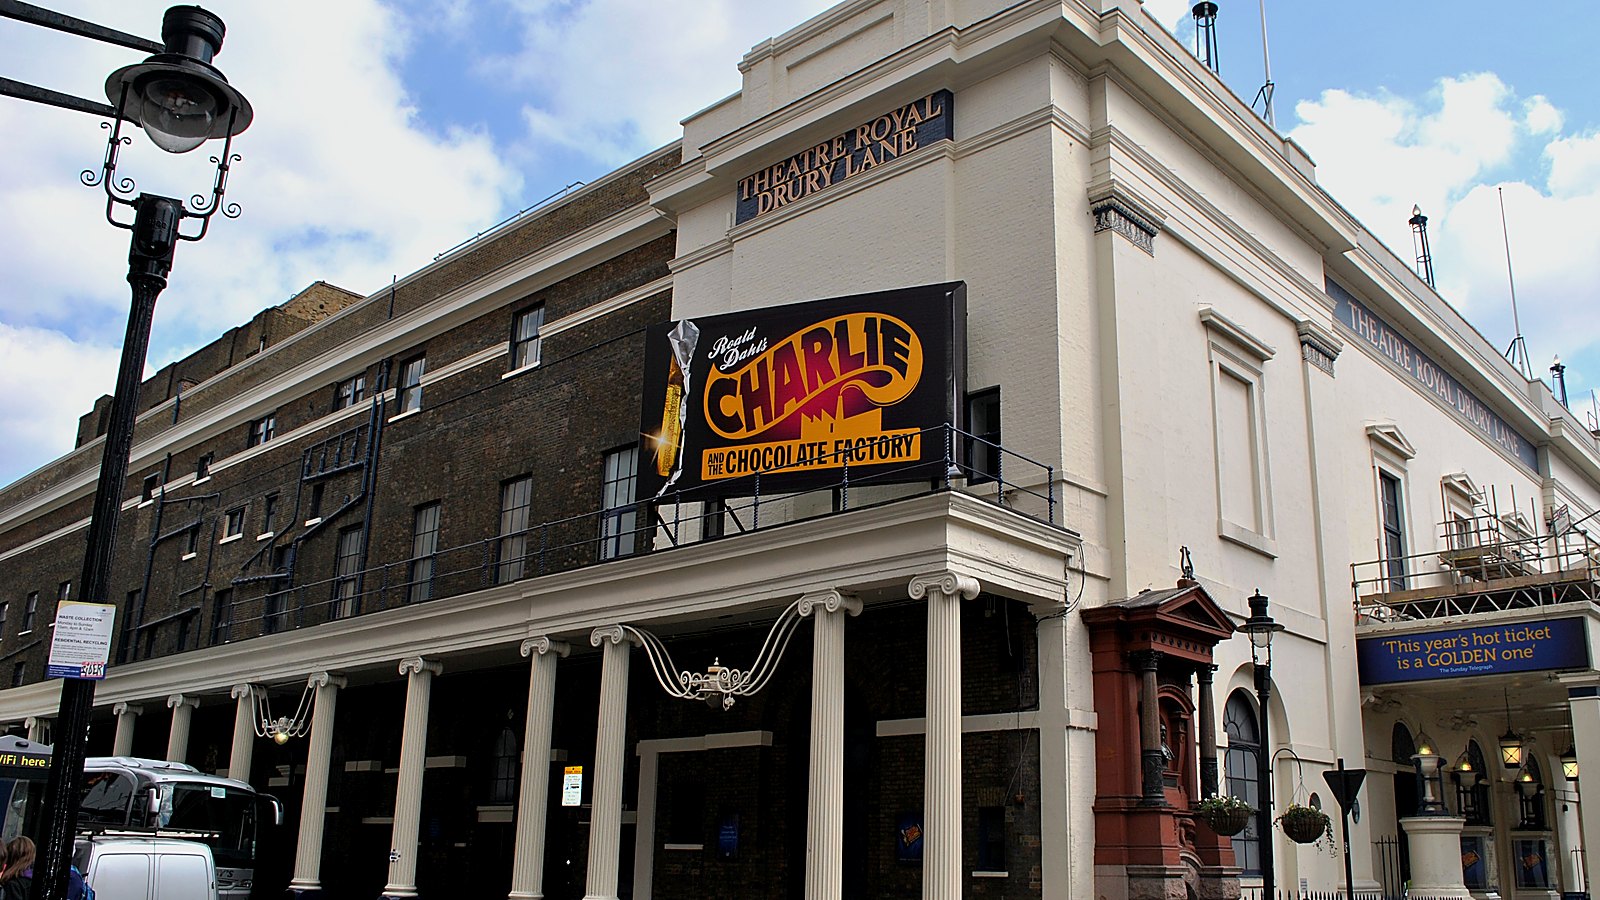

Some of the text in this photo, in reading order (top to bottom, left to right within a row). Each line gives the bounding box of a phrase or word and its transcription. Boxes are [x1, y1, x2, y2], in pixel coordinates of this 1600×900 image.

[739, 94, 942, 201] THEATRE ROYAL
[756, 126, 919, 217] DRURY LANE
[707, 326, 757, 359] Roald
[720, 337, 768, 371] Dahl's
[708, 316, 911, 433] CHARLIE
[1347, 300, 1521, 458] THEATRE ROYAL DRURY LANE
[708, 452, 724, 464] AND
[708, 463, 724, 476] THE
[725, 434, 914, 474] CHOCOLATE FACTORY
[1382, 626, 1552, 654] 'This year's hot ticket
[1397, 644, 1536, 670] is a GOLDEN one'
[21, 755, 46, 767] here
